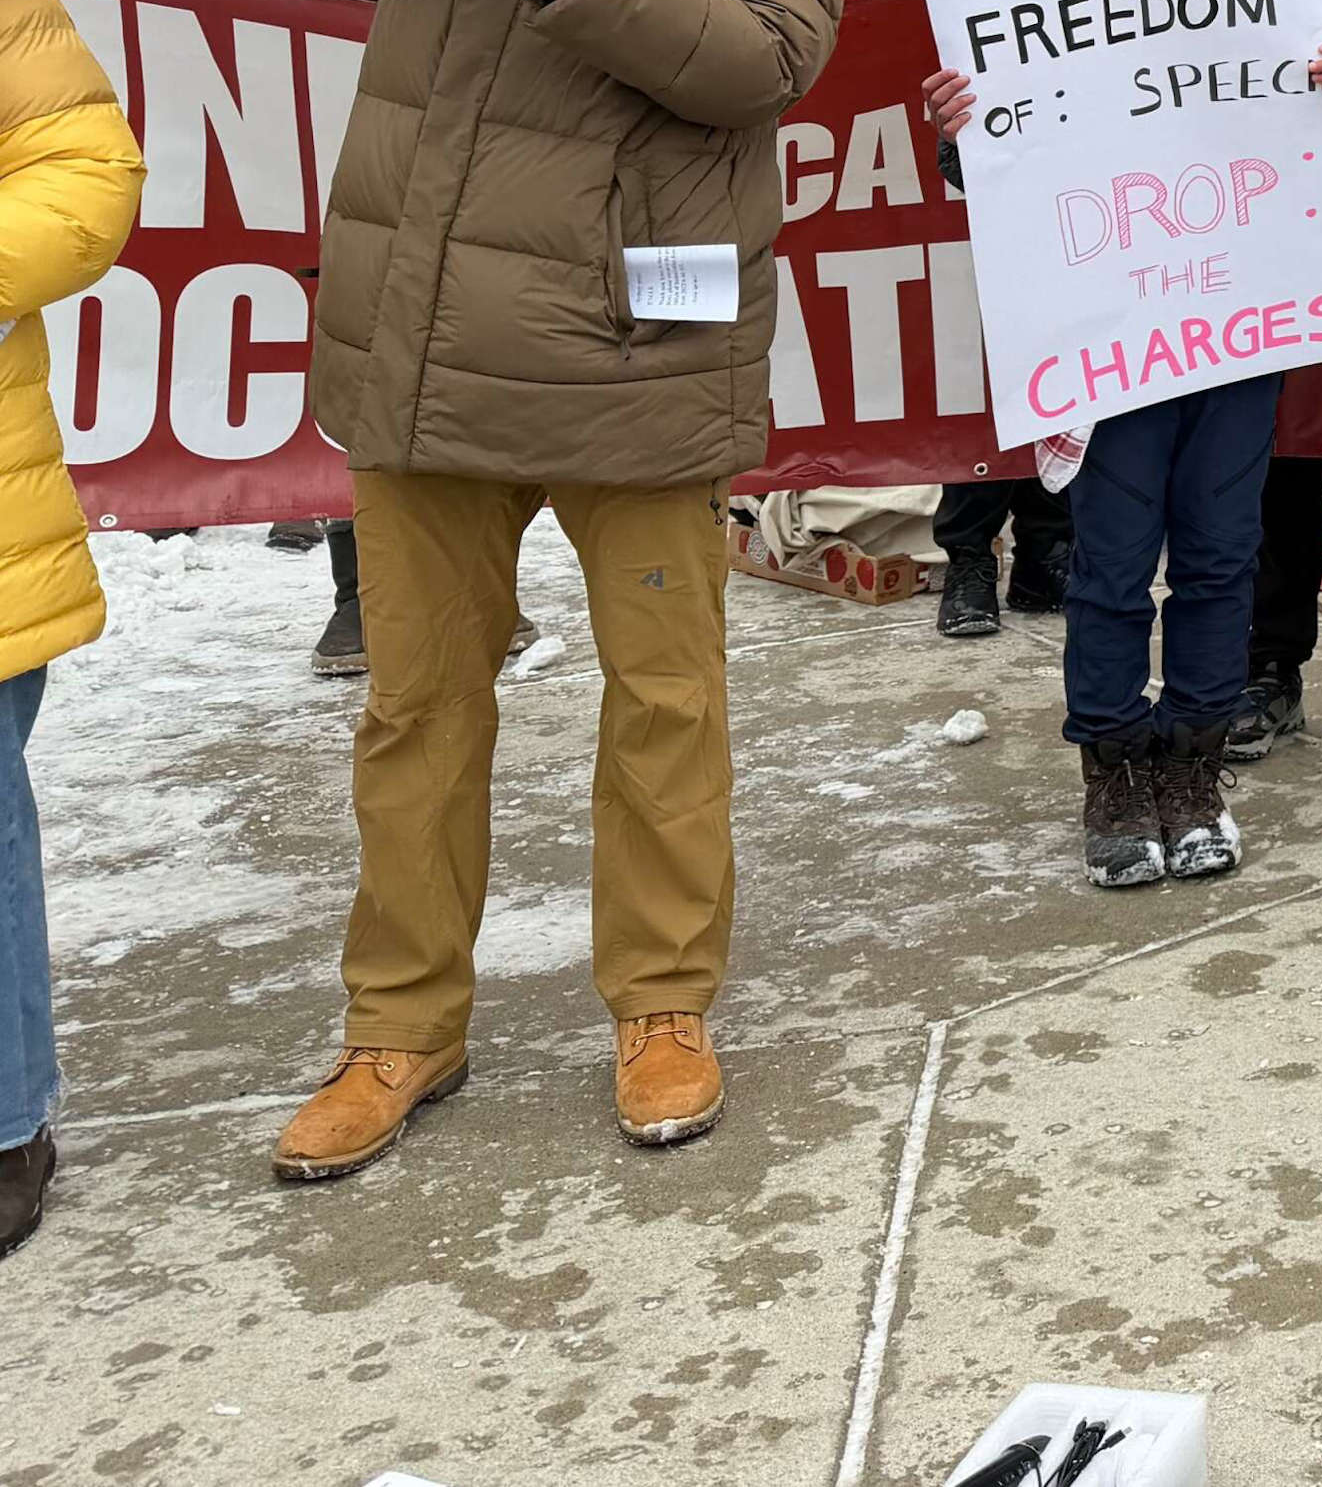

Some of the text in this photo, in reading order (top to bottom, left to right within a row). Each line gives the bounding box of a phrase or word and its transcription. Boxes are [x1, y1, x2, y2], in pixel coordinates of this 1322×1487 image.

[1130, 59, 1317, 117] SPEEC
[775, 101, 966, 223] CA
[1128, 251, 1232, 299] THE
[41, 263, 349, 464] OC
